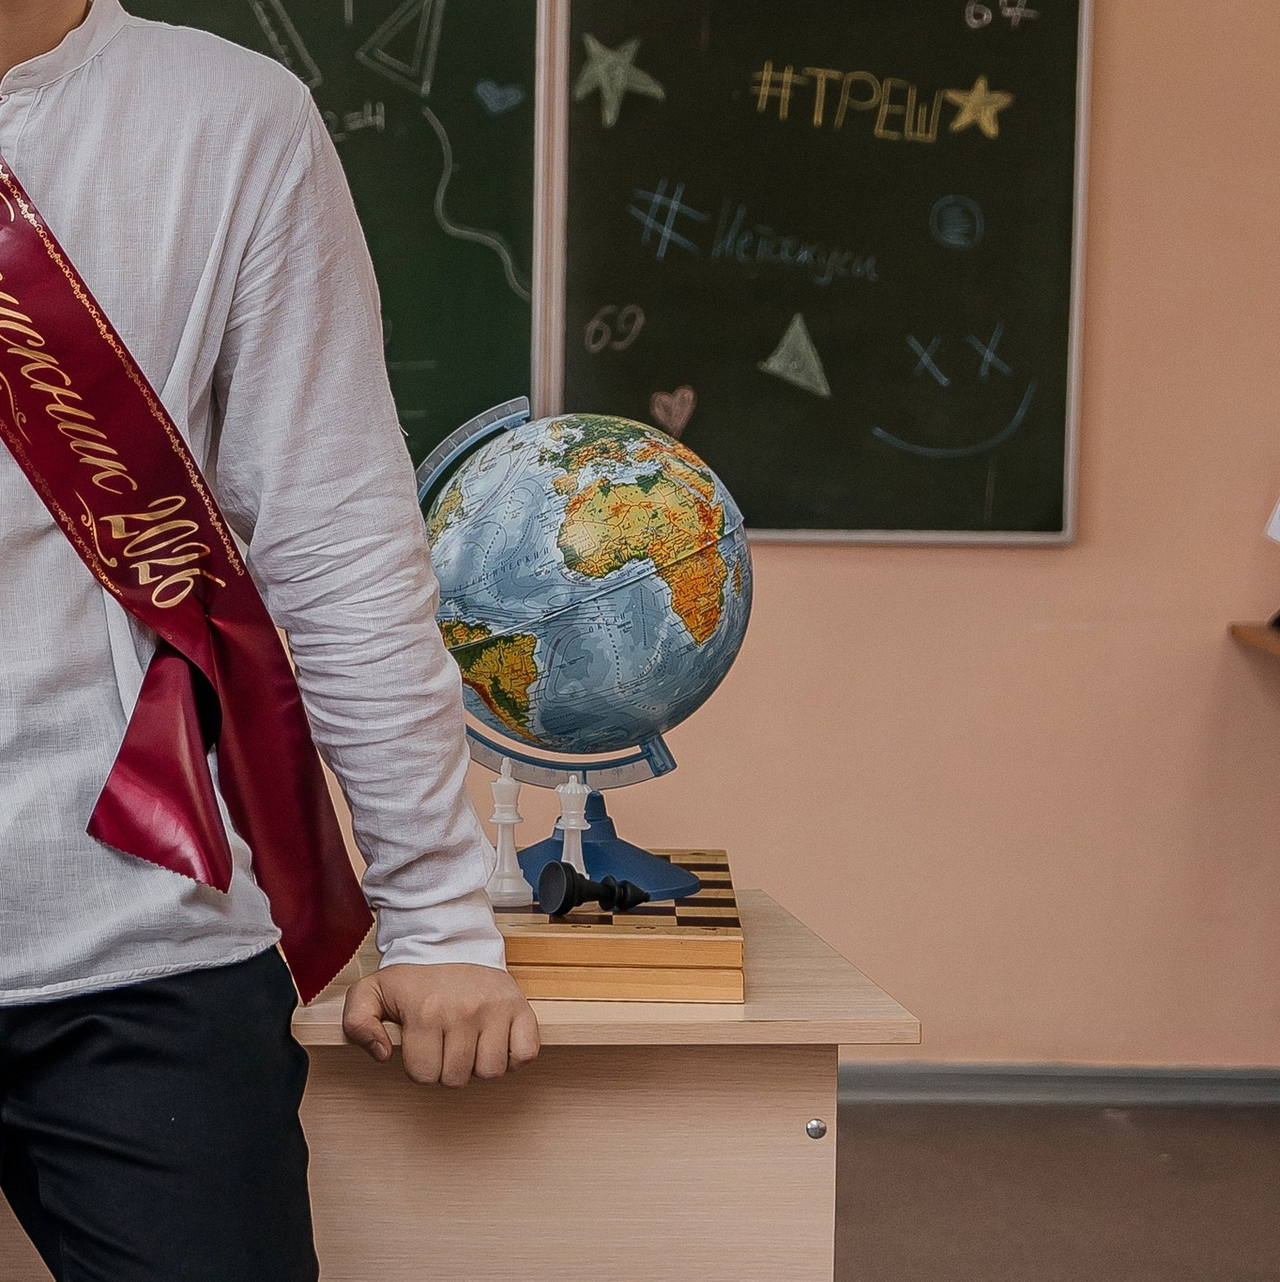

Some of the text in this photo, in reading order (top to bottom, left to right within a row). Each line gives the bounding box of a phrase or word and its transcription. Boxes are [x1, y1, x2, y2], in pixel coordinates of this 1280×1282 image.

[751, 60, 948, 143] #ТРЕШ
[585, 303, 646, 354] 69
[99, 495, 226, 609] 2026
